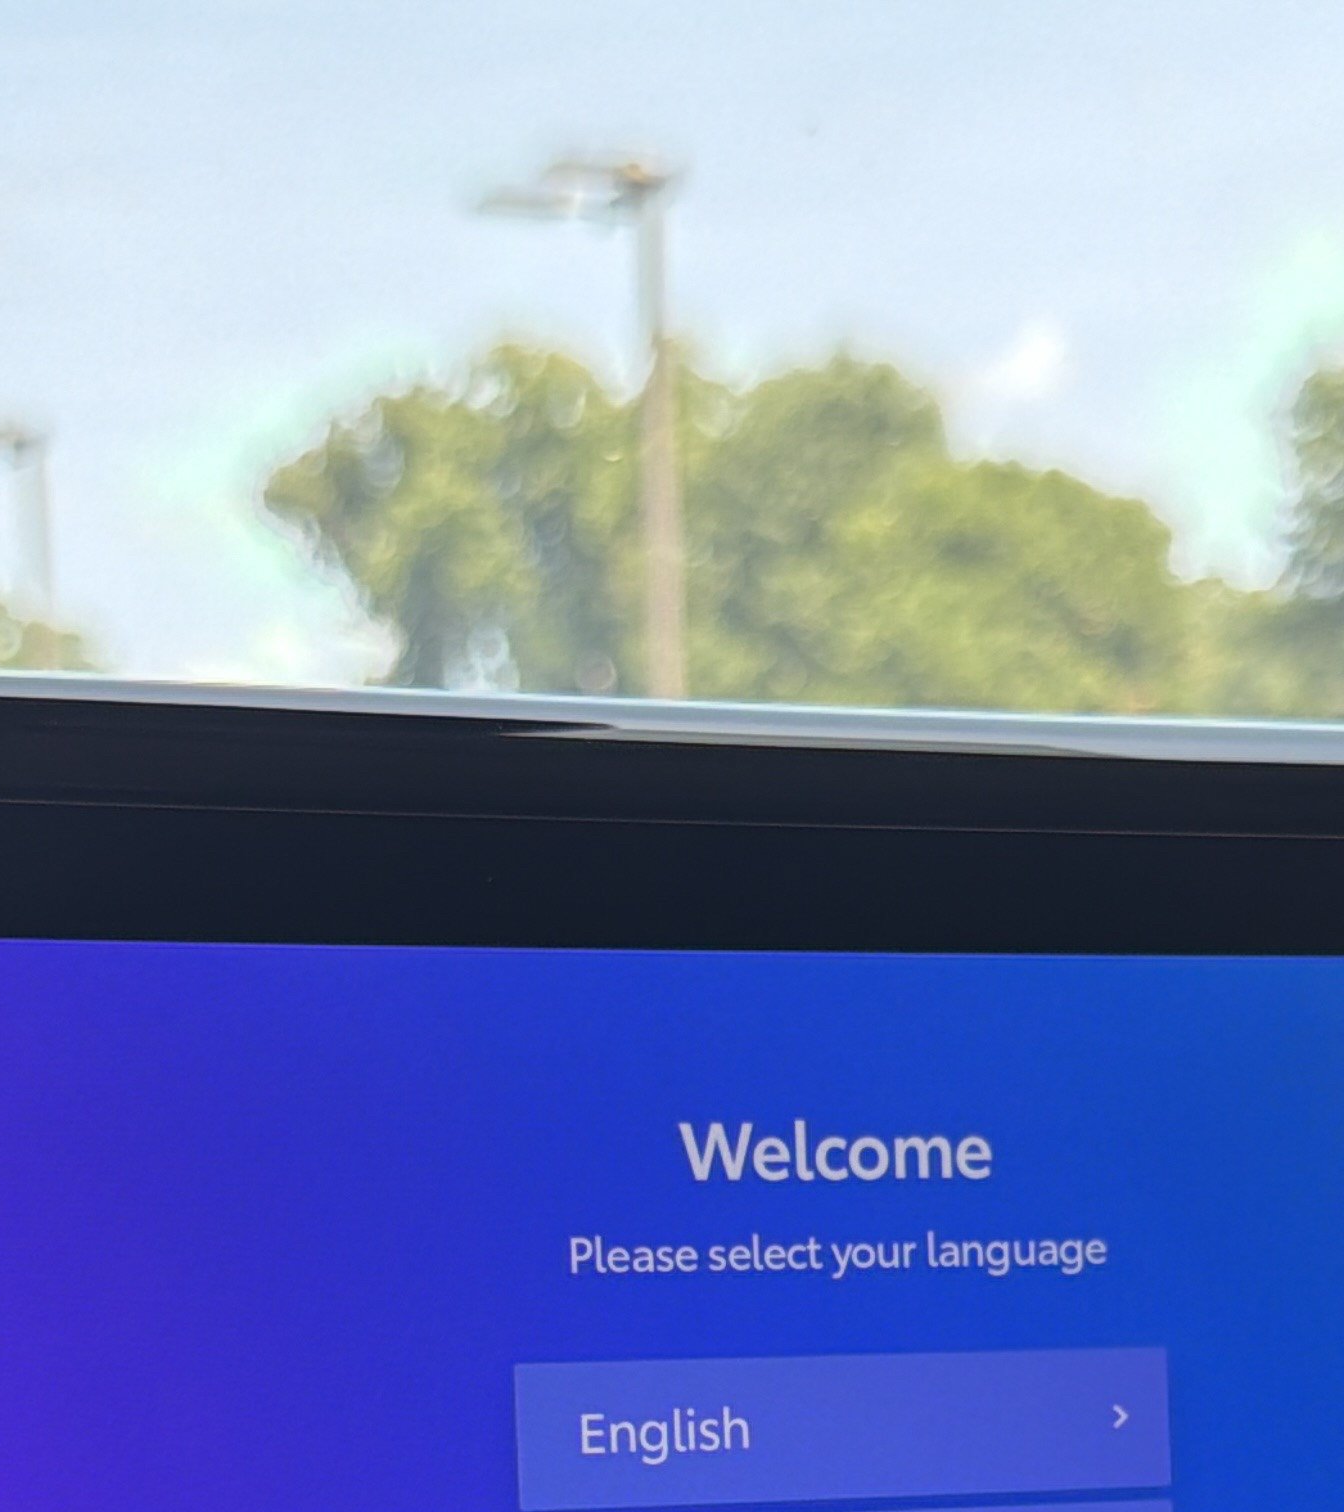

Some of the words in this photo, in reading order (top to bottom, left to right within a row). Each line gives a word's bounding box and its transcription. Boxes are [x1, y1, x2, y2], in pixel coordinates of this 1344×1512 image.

[678, 1119, 993, 1182] Welcome
[569, 1235, 699, 1274] Please
[708, 1233, 824, 1272] select
[830, 1242, 917, 1280] your
[926, 1230, 1108, 1277] language
[580, 1406, 750, 1466] English
